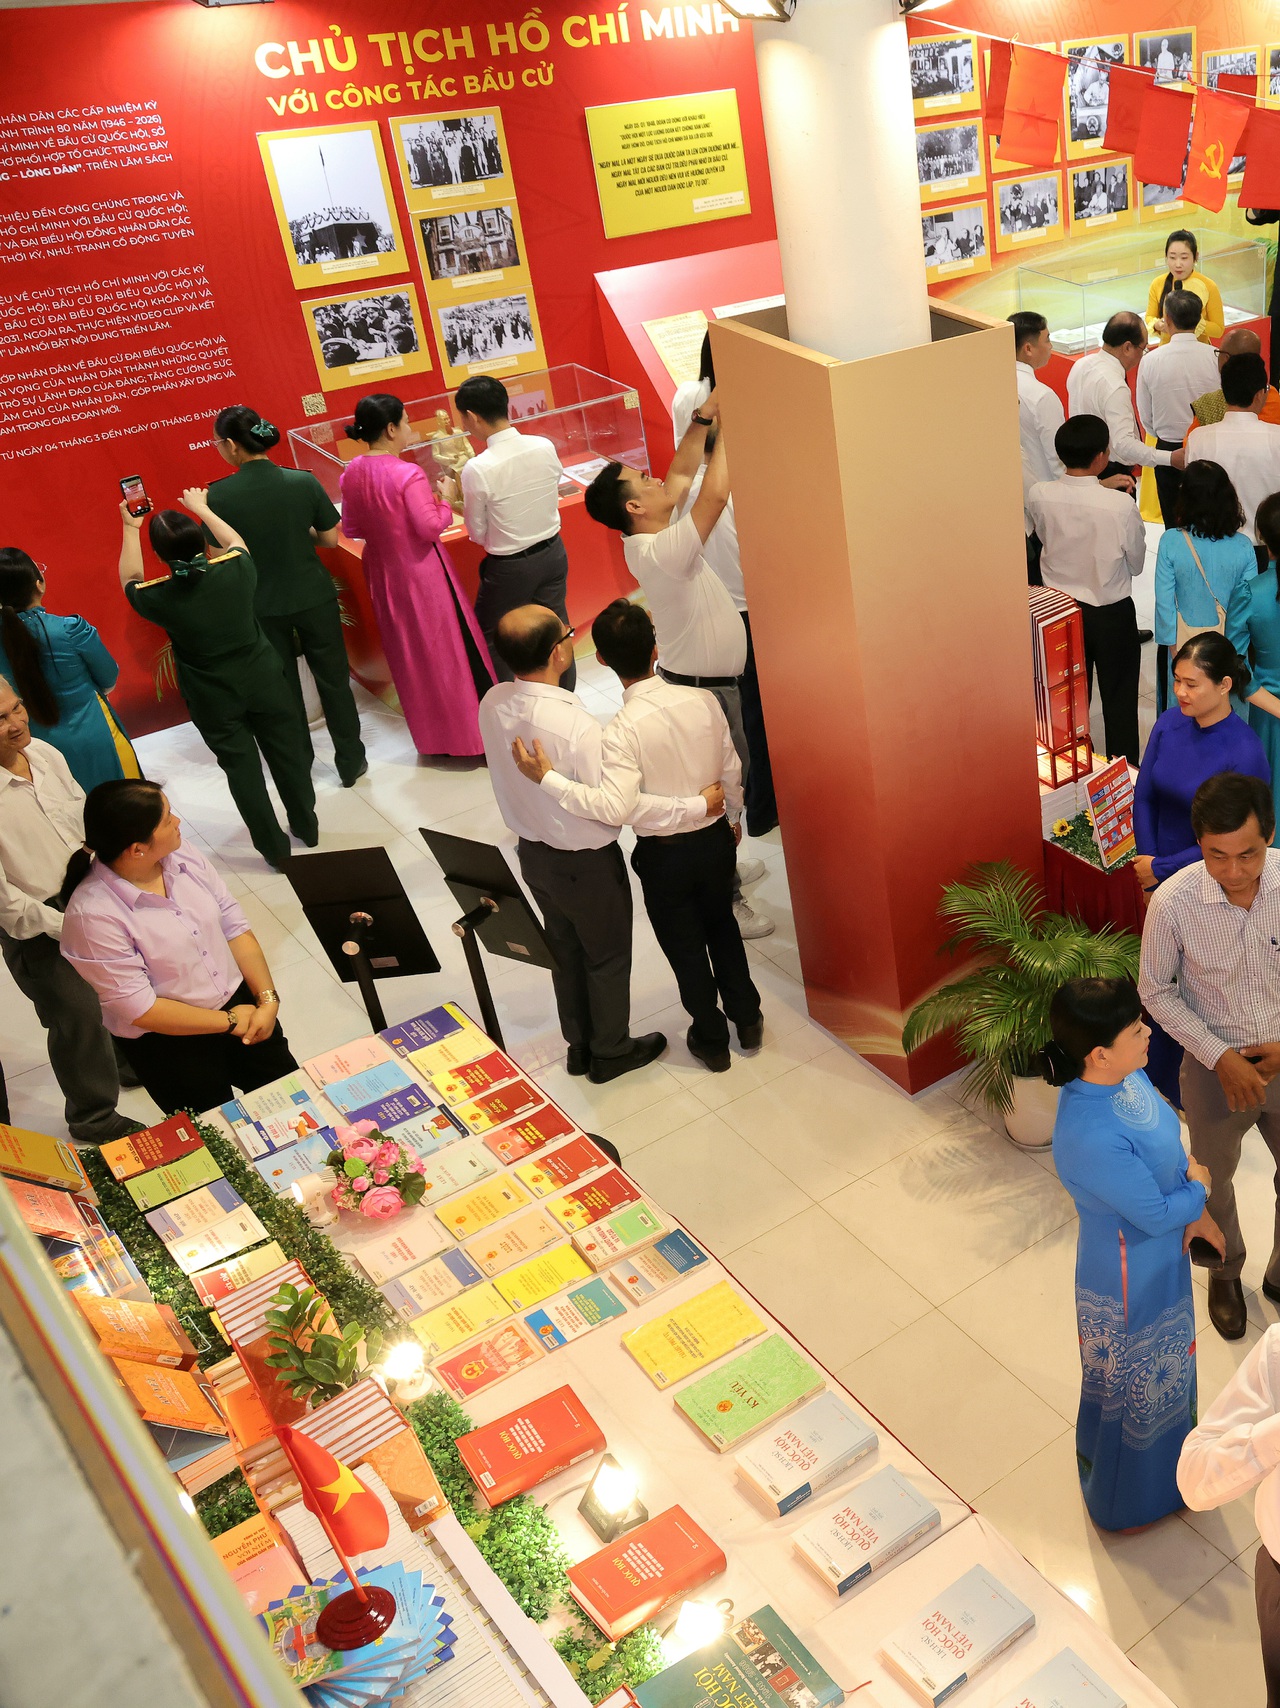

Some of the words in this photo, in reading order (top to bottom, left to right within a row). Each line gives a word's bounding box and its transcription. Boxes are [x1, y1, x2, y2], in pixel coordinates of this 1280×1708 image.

[254, 24, 358, 79] CHỦ
[368, 25, 475, 75] TỊCH
[486, 7, 550, 56] HỒ
[562, 2, 630, 48] CHÍ
[640, 2, 740, 41] MINH
[266, 88, 319, 116] VỚI
[325, 82, 401, 110] CÔNG
[406, 74, 458, 100] TÁC
[463, 66, 514, 94] BẦU
[521, 60, 554, 87] CỬ
[0, 113, 27, 124] HÂN
[29, 110, 55, 122] DÂN
[57, 108, 80, 119] CÁC
[82, 104, 104, 116] CẤP
[106, 102, 142, 114] NHIỆM
[144, 100, 157, 110] KỲ
[20, 125, 55, 136] TRÌNH
[56, 124, 71, 133] 80
[72, 120, 98, 131] NĂM
[100, 118, 126, 130] (1946
[134, 114, 162, 125] 2026)
[10, 141, 40, 152] MINH
[40, 137, 56, 148] VỀ
[56, 135, 79, 147] BẦU
[81, 133, 96, 144] CỬ
[97, 130, 128, 144] QUỐC
[129, 128, 151, 140] HỘI,
[151, 125, 166, 136] SỞ
[14, 152, 42, 165] PHỐI
[42, 152, 66, 163] HỢP
[66, 148, 82, 159] TỔ
[82, 146, 112, 158] CHỨC
[111, 143, 148, 154] TRƯNG
[149, 140, 168, 150] BÀY
[19, 168, 52, 178] LÒNG
[52, 163, 86, 175] DÂN”,
[86, 158, 118, 171] TRIỂN
[120, 156, 143, 167] LÃM
[144, 153, 173, 164] SÁCH
[23, 327, 58, 340] NGOÀI
[58, 325, 76, 334] RA,
[76, 320, 105, 331] THỰC
[105, 315, 130, 326] HIỆN
[130, 310, 162, 322] VIDEO
[163, 306, 184, 316] CLIP
[184, 302, 199, 312] VÀ
[198, 299, 215, 310] KẾT
[0, 450, 14, 460] TỪ
[16, 445, 43, 458] NGÀY
[44, 443, 58, 452] 04
[58, 435, 94, 448] THÁNG
[93, 434, 100, 442] 3
[101, 428, 122, 440] ĐẾN
[123, 423, 149, 435] NGÀY
[150, 421, 160, 430] 01
[160, 414, 193, 427] THÁNG
[200, 408, 222, 419] NĂM
[499, 1430, 511, 1444] HỘI
[773, 1435, 792, 1452] HỘI
[783, 1429, 805, 1448] NAM
[506, 1441, 523, 1460] QUỐC
[785, 1448, 812, 1473] QUỐC
[800, 1444, 820, 1465] VIỆT
[832, 1512, 851, 1530] HỘI
[842, 1506, 863, 1526] NAM
[845, 1527, 872, 1552] QUỐC
[859, 1523, 880, 1544] VIỆT
[611, 1556, 627, 1570] HỘI
[620, 1567, 642, 1587] QUỐC
[921, 1617, 942, 1637] HỘI
[931, 1610, 956, 1632] NAM
[938, 1634, 966, 1660] QUỐC
[952, 1628, 974, 1652] VIỆT
[694, 1666, 723, 1697] HỘI
[712, 1662, 741, 1694] NAM
